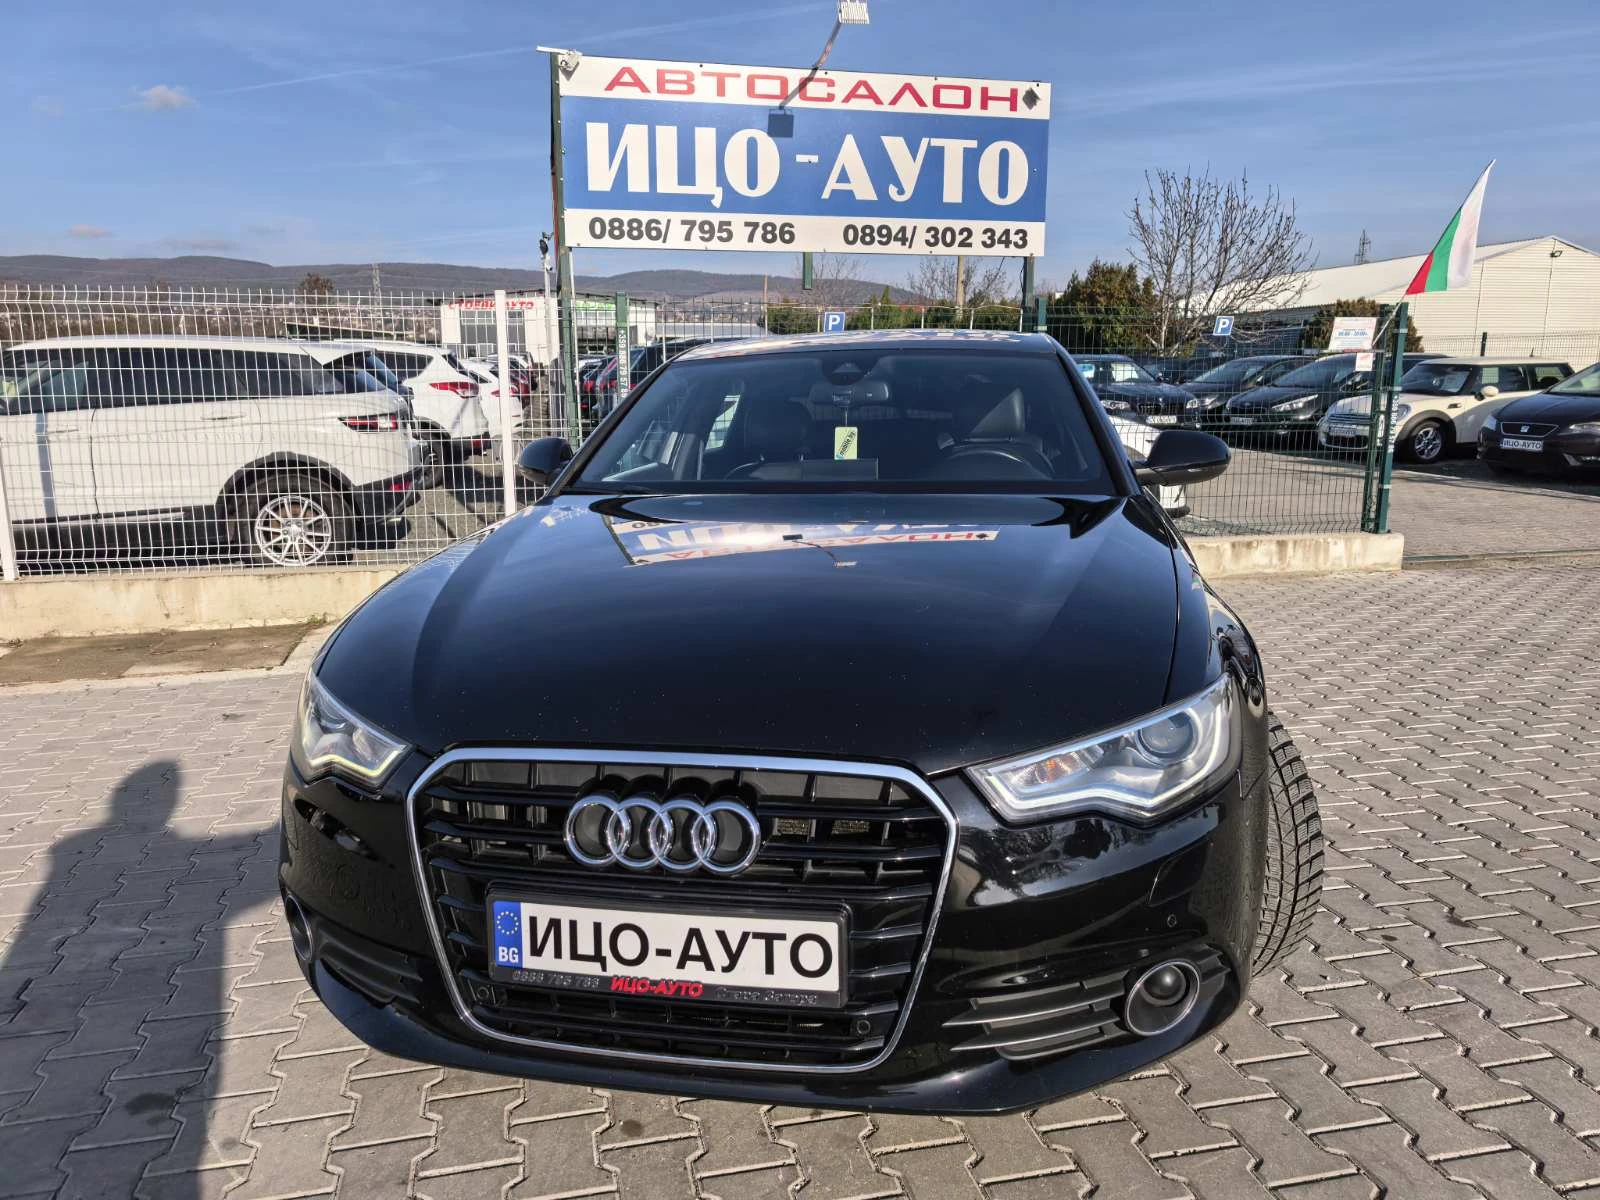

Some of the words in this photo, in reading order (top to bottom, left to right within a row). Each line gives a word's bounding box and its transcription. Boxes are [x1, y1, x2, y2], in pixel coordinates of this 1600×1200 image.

[604, 67, 1018, 112] АВТОСАЛОН
[589, 217, 671, 243] 0886/
[680, 219, 733, 242] 795
[743, 221, 796, 244] 786
[843, 224, 917, 249] 0894/
[925, 226, 973, 248] 302
[981, 227, 1028, 249] 343
[828, 314, 841, 331] P
[1217, 318, 1230, 334] P
[498, 946, 519, 964] BG
[528, 915, 833, 978] ИЦО-АУТО
[610, 975, 704, 999] ИЦО-АУТО
